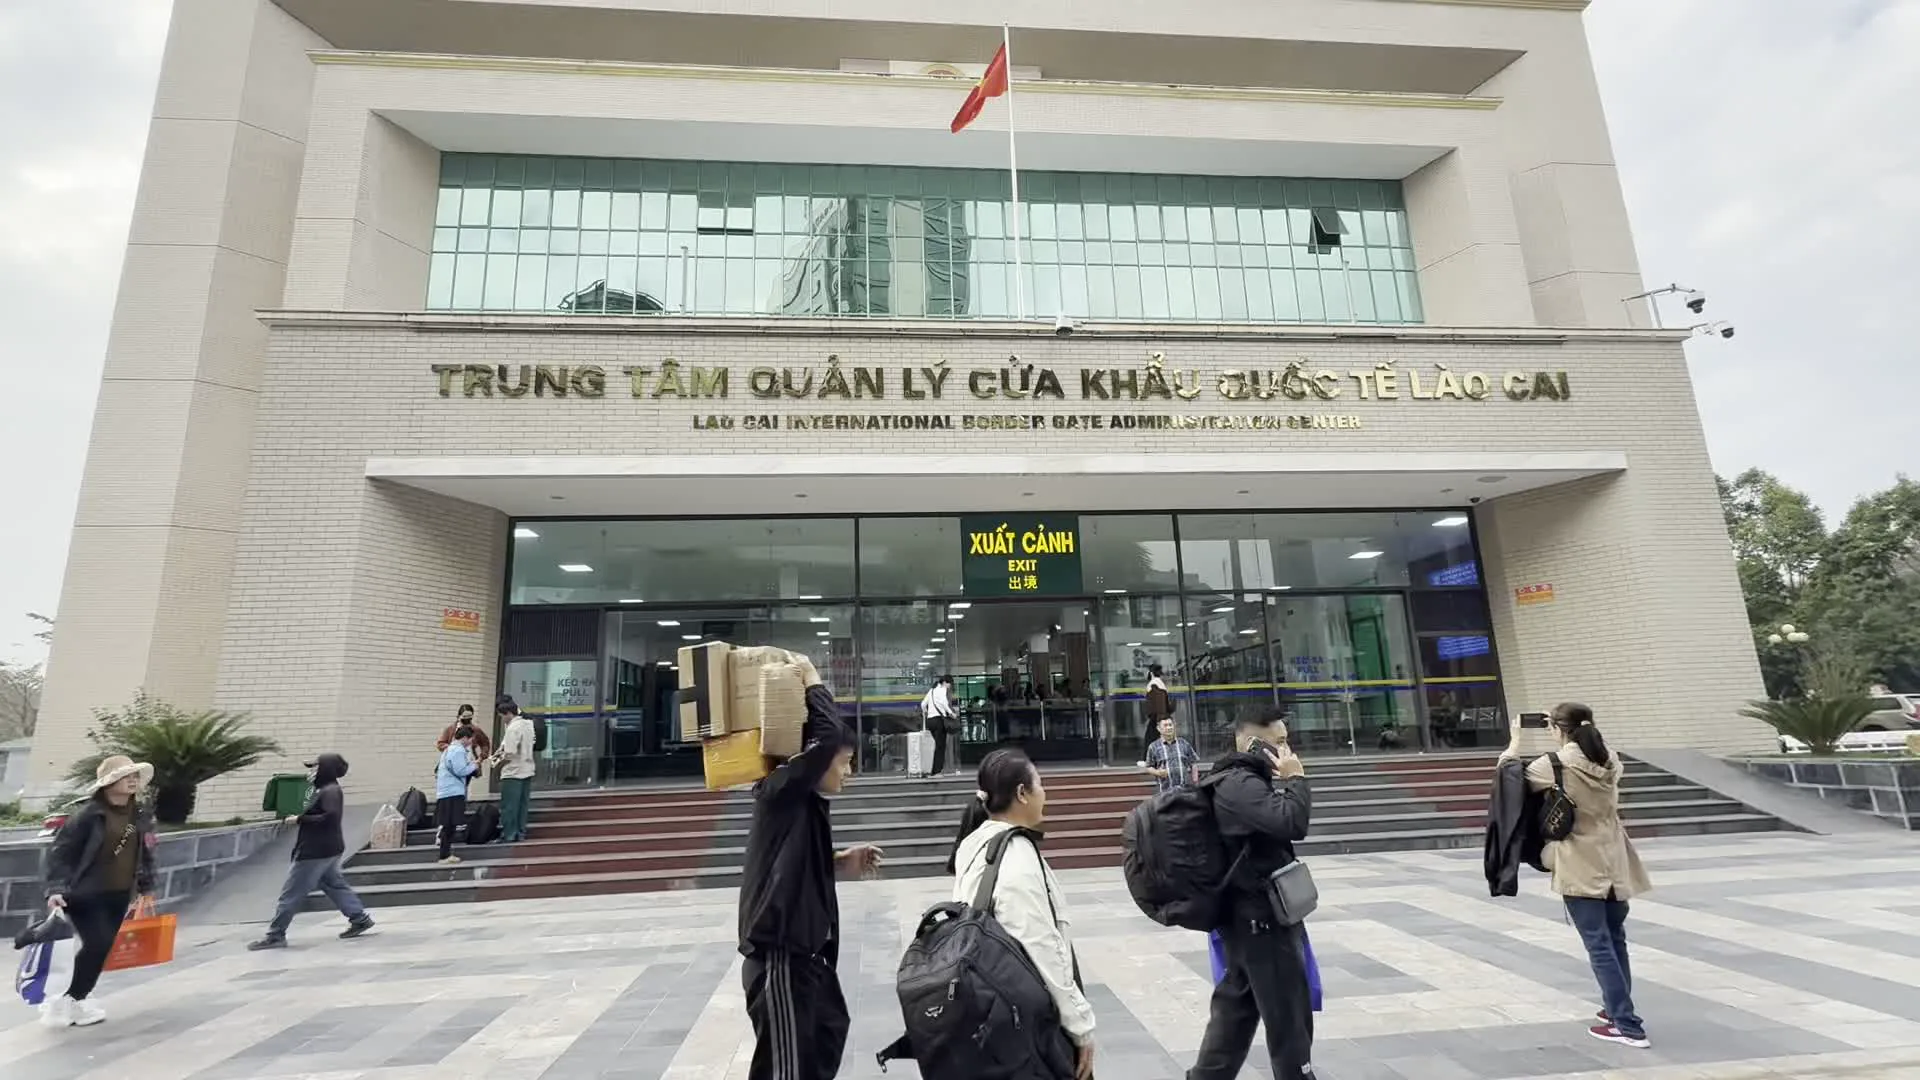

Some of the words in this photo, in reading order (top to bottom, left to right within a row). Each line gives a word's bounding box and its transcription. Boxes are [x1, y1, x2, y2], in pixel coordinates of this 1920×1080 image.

[431, 362, 606, 398] TRUNG
[623, 358, 728, 398] TÂM
[751, 354, 884, 399] QUẢN
[903, 359, 951, 399] LÝ
[968, 354, 1065, 400] CỬA
[1080, 351, 1201, 400] KHẨU
[1218, 355, 1340, 400] QUỐC
[1350, 359, 1400, 400] TẾ
[1408, 363, 1490, 400] LÀO
[1503, 370, 1570, 400] CAI
[693, 415, 734, 430] LAO
[743, 415, 778, 429] CAI
[787, 415, 953, 430] INTERNATIONAL
[962, 415, 1045, 430] BORDER
[1052, 415, 1103, 429] GATE
[1110, 415, 1281, 430] ADMINISTRATION
[1287, 415, 1361, 430] CENTER
[970, 522, 1016, 554] XUẤT
[1022, 524, 1074, 553] CẢNH
[1008, 560, 1037, 571] EXIT
[1009, 575, 1038, 589] 出境
